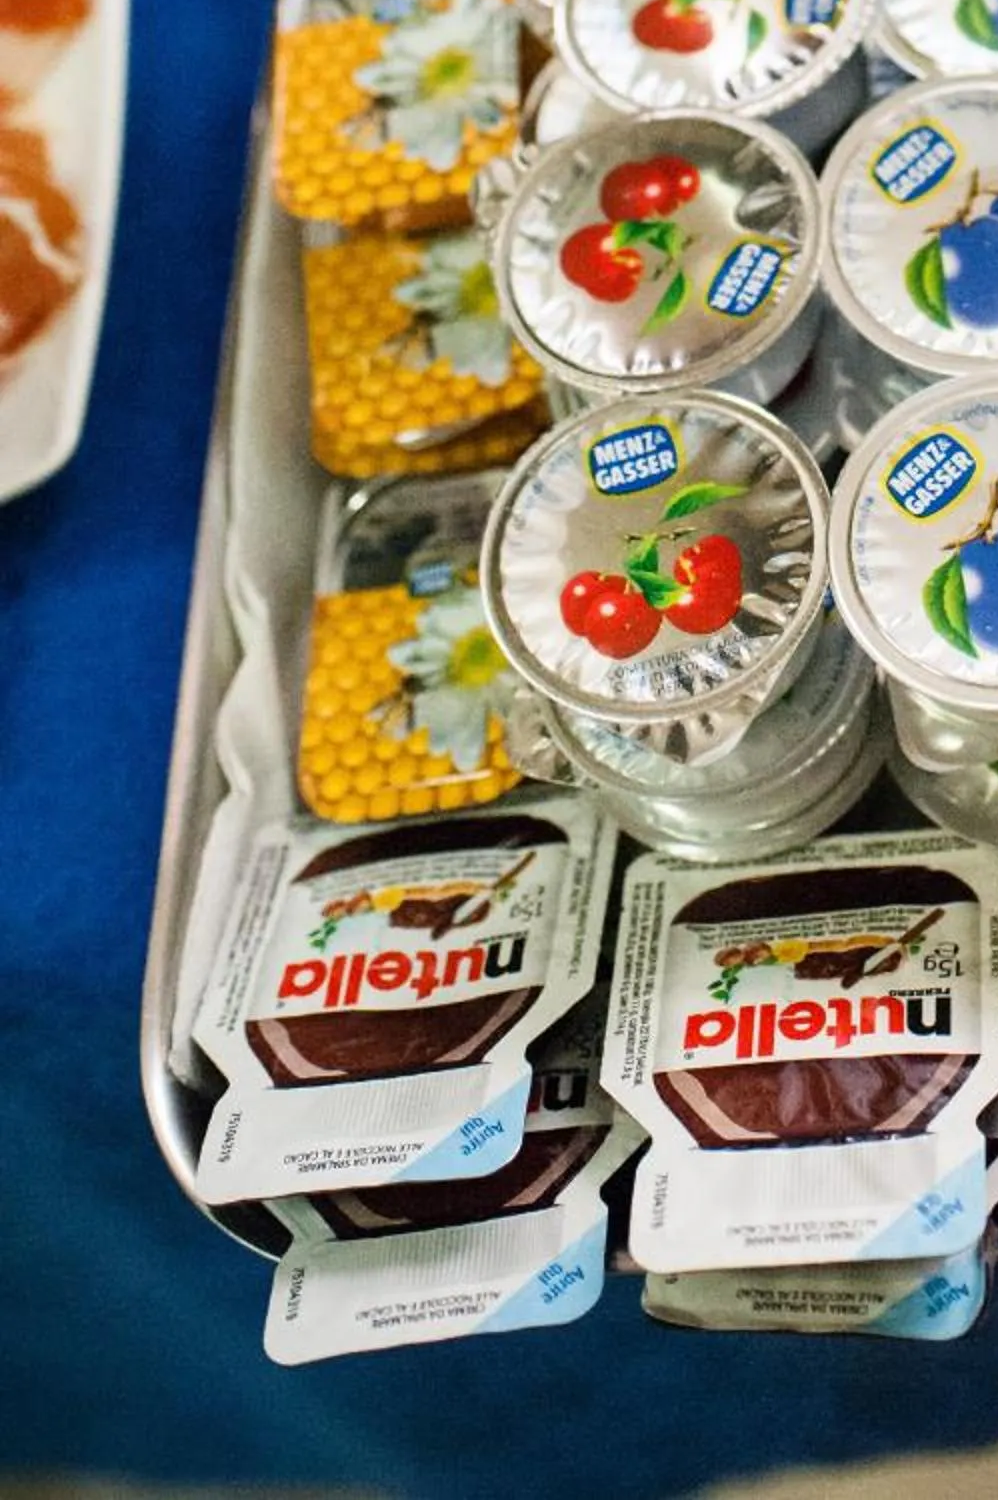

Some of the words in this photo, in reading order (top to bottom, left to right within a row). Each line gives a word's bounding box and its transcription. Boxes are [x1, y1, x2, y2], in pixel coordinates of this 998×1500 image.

[595, 450, 675, 490] GASSER
[904, 451, 973, 514] GASSER
[279, 937, 525, 1006] nutella
[923, 955, 964, 978] 15g
[683, 996, 952, 1059] nutella
[460, 1117, 485, 1137] qui
[461, 1120, 504, 1157] Aprire
[283, 1151, 319, 1166] CACAO
[298, 1160, 351, 1174] SPALMARE
[353, 1157, 369, 1168] DA
[371, 1154, 407, 1167] CREMA
[537, 1263, 563, 1287] qui
[541, 1265, 585, 1305] Aprire
[355, 1304, 393, 1322] CACAO
[429, 1309, 445, 1319] DA
[447, 1302, 486, 1317] CREMA
[372, 1312, 427, 1329] SPALMARE
